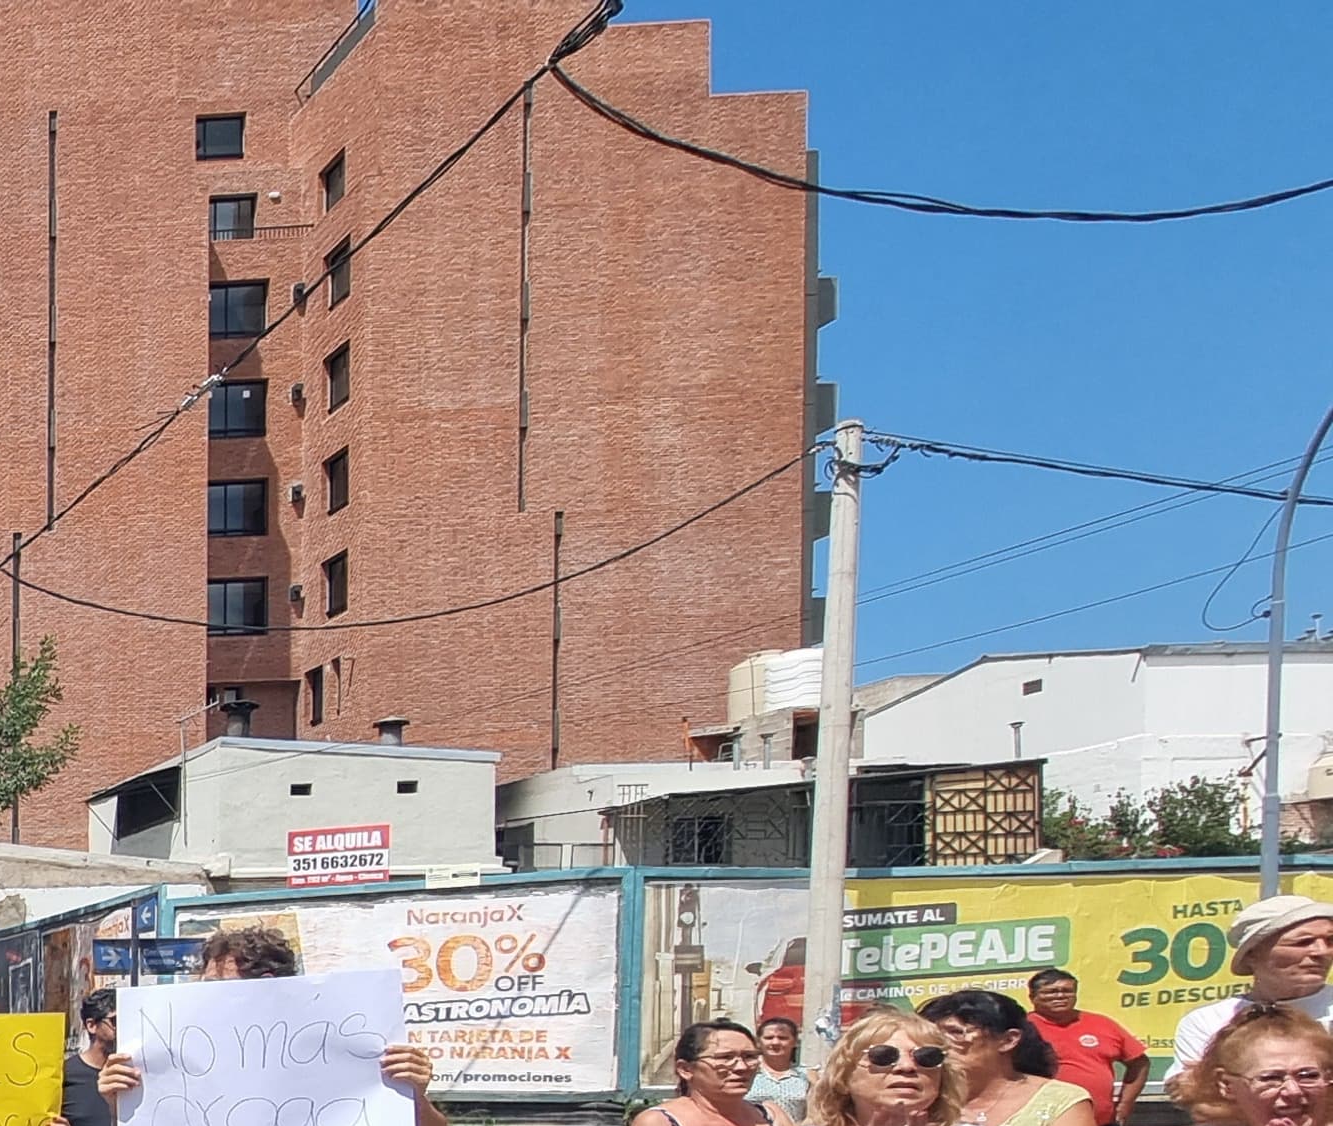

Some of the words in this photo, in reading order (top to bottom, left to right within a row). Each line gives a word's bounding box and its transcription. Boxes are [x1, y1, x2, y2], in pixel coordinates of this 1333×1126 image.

[292, 836, 313, 853] SE
[315, 830, 382, 851] ALQUILA
[292, 858, 317, 872] 351
[321, 853, 384, 870] 6632672
[842, 909, 918, 928] SUMATE
[922, 908, 946, 922] AL
[1172, 899, 1244, 920] HASTA
[841, 925, 1056, 975] TelePEAJE
[387, 932, 547, 993] 30%
[494, 974, 545, 992] OFF
[856, 985, 925, 1000] CAMINOS
[929, 983, 948, 996] DE
[1121, 991, 1151, 1008] DE
[139, 1000, 216, 1078] No
[233, 993, 389, 1070] más
[427, 1029, 515, 1046] TARJETA
[519, 1029, 548, 1044] DE
[449, 1046, 550, 1062] NARANJA
[554, 1046, 573, 1060] X
